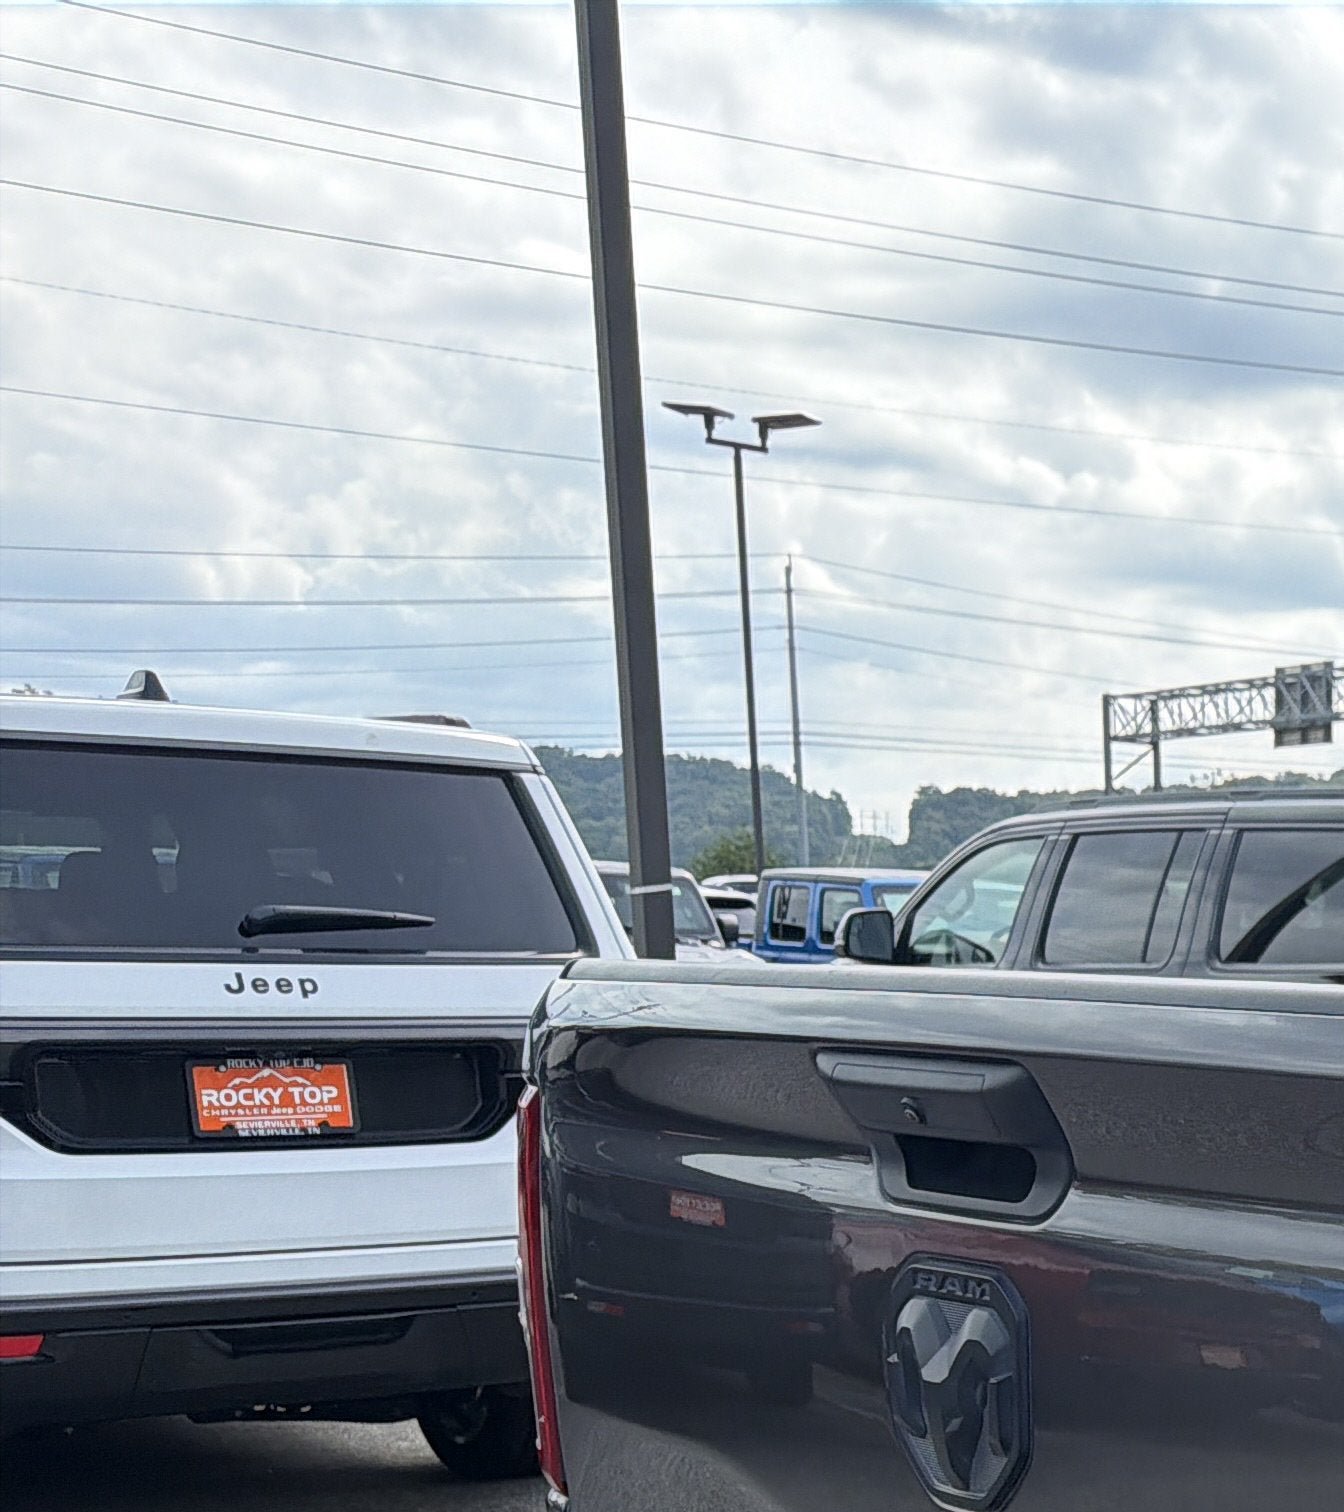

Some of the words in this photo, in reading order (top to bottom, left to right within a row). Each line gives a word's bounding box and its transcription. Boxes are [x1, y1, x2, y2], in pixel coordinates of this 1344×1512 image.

[223, 971, 319, 999] Jeep
[226, 1058, 265, 1069] ROCKY
[201, 1087, 283, 1107] ROCKY
[288, 1086, 338, 1104] TOP
[202, 1107, 268, 1117] CHRYSLER
[296, 1104, 343, 1113] DODGE
[913, 1272, 990, 1300] RAM
